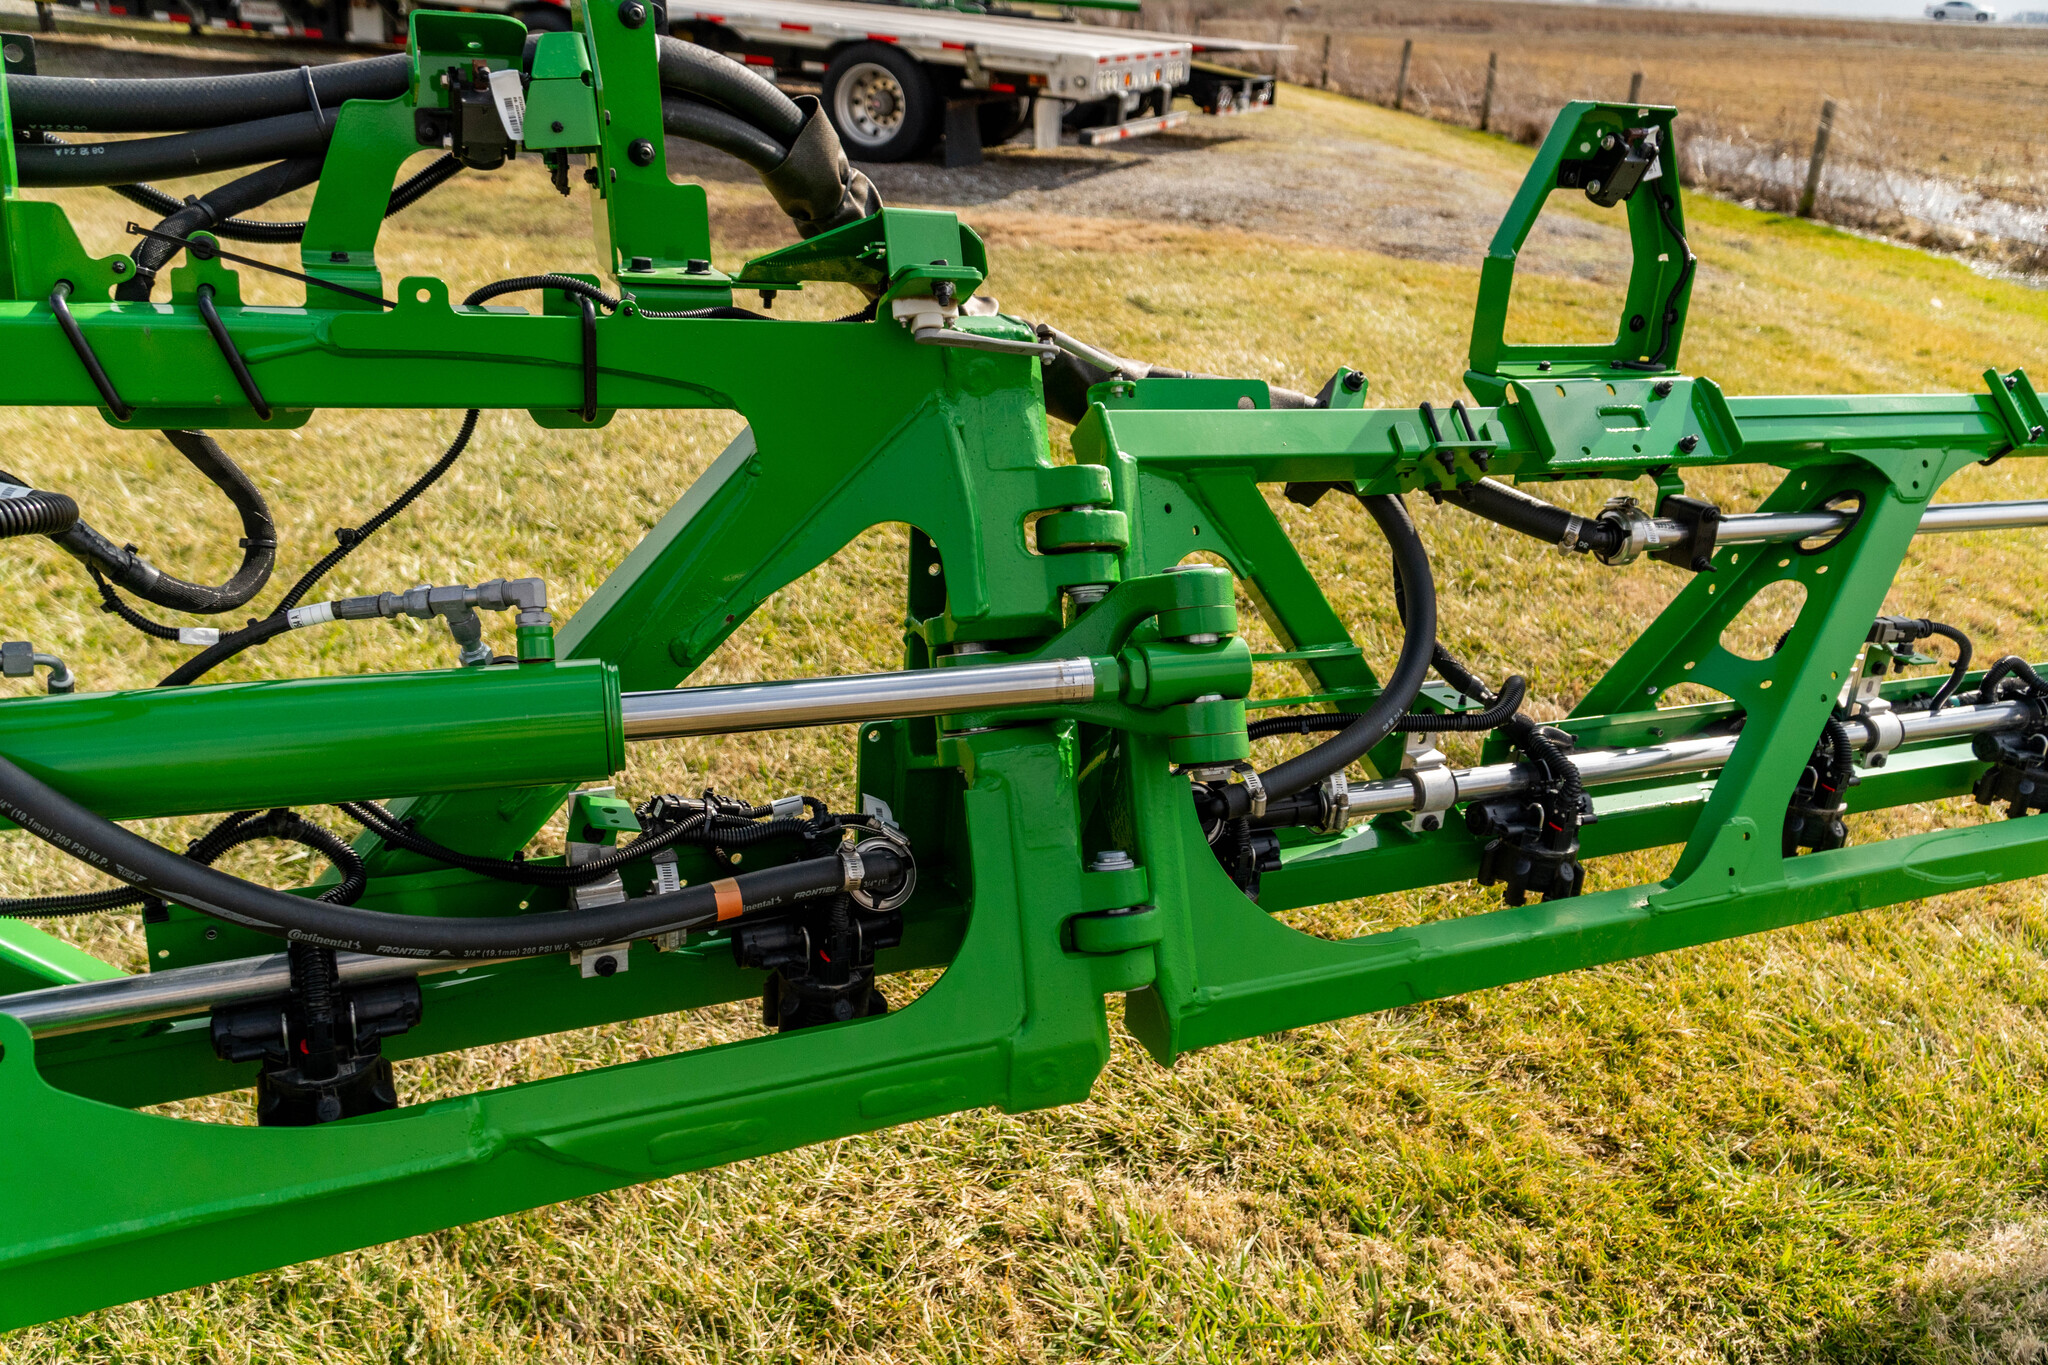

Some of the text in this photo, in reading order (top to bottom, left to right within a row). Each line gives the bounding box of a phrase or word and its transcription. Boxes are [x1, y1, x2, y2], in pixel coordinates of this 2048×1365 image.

[54, 148, 63, 157] A
[63, 147, 76, 156] 24
[10, 808, 54, 838] (19.1mm)
[53, 832, 71, 847] 200
[71, 841, 89, 857] PSI
[89, 850, 109, 868] W.P.
[743, 897, 775, 913] inental
[793, 885, 838, 900] FRONTIER
[288, 928, 353, 950] Continental
[376, 945, 431, 956] FRONTIER
[463, 949, 480, 958] 3/4"
[481, 948, 521, 958] (19.1mm)
[522, 946, 536, 956] 200
[538, 945, 552, 953] PSI
[554, 943, 572, 952] W.P.
